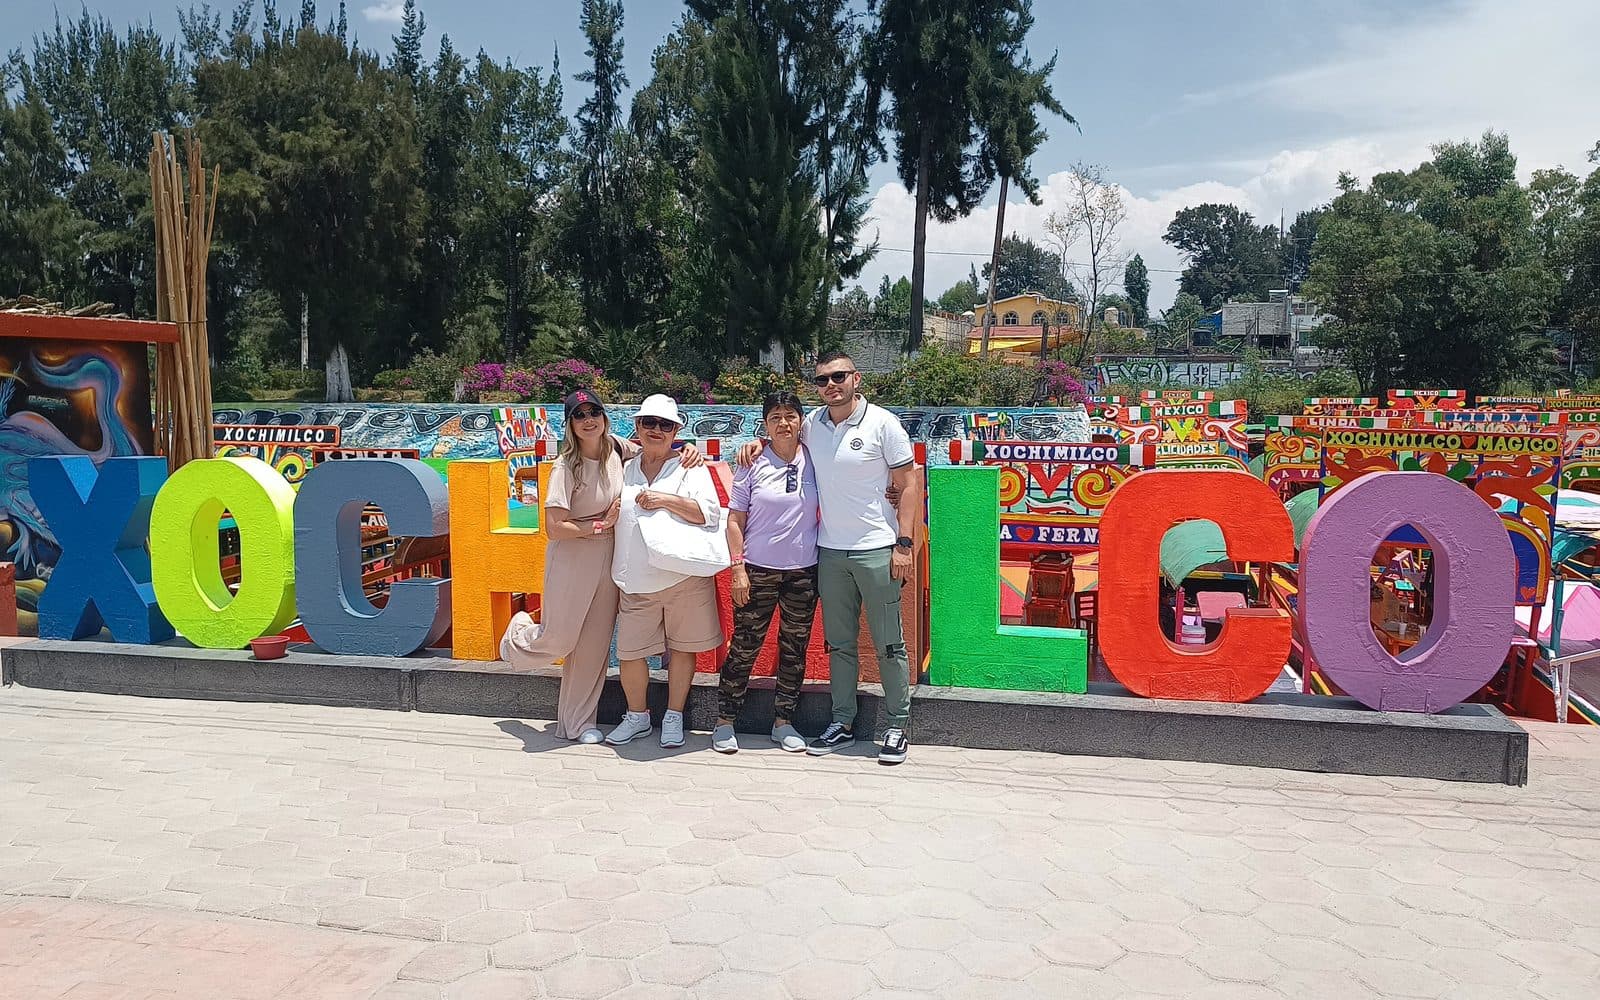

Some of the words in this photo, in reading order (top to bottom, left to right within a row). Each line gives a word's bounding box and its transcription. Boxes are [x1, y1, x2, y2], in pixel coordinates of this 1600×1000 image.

[1155, 404, 1204, 417] MEXICO
[1453, 413, 1529, 422] LINDA
[1308, 417, 1357, 428] LINDA
[223, 427, 325, 443] XOCHIMILCO
[1327, 432, 1462, 449] XOCHIMILCO
[1476, 435, 1558, 452] MAGICO
[984, 444, 1119, 462] XOCHIMILCO
[1156, 444, 1217, 455] ELICIDADES
[1037, 526, 1099, 543] FERN
